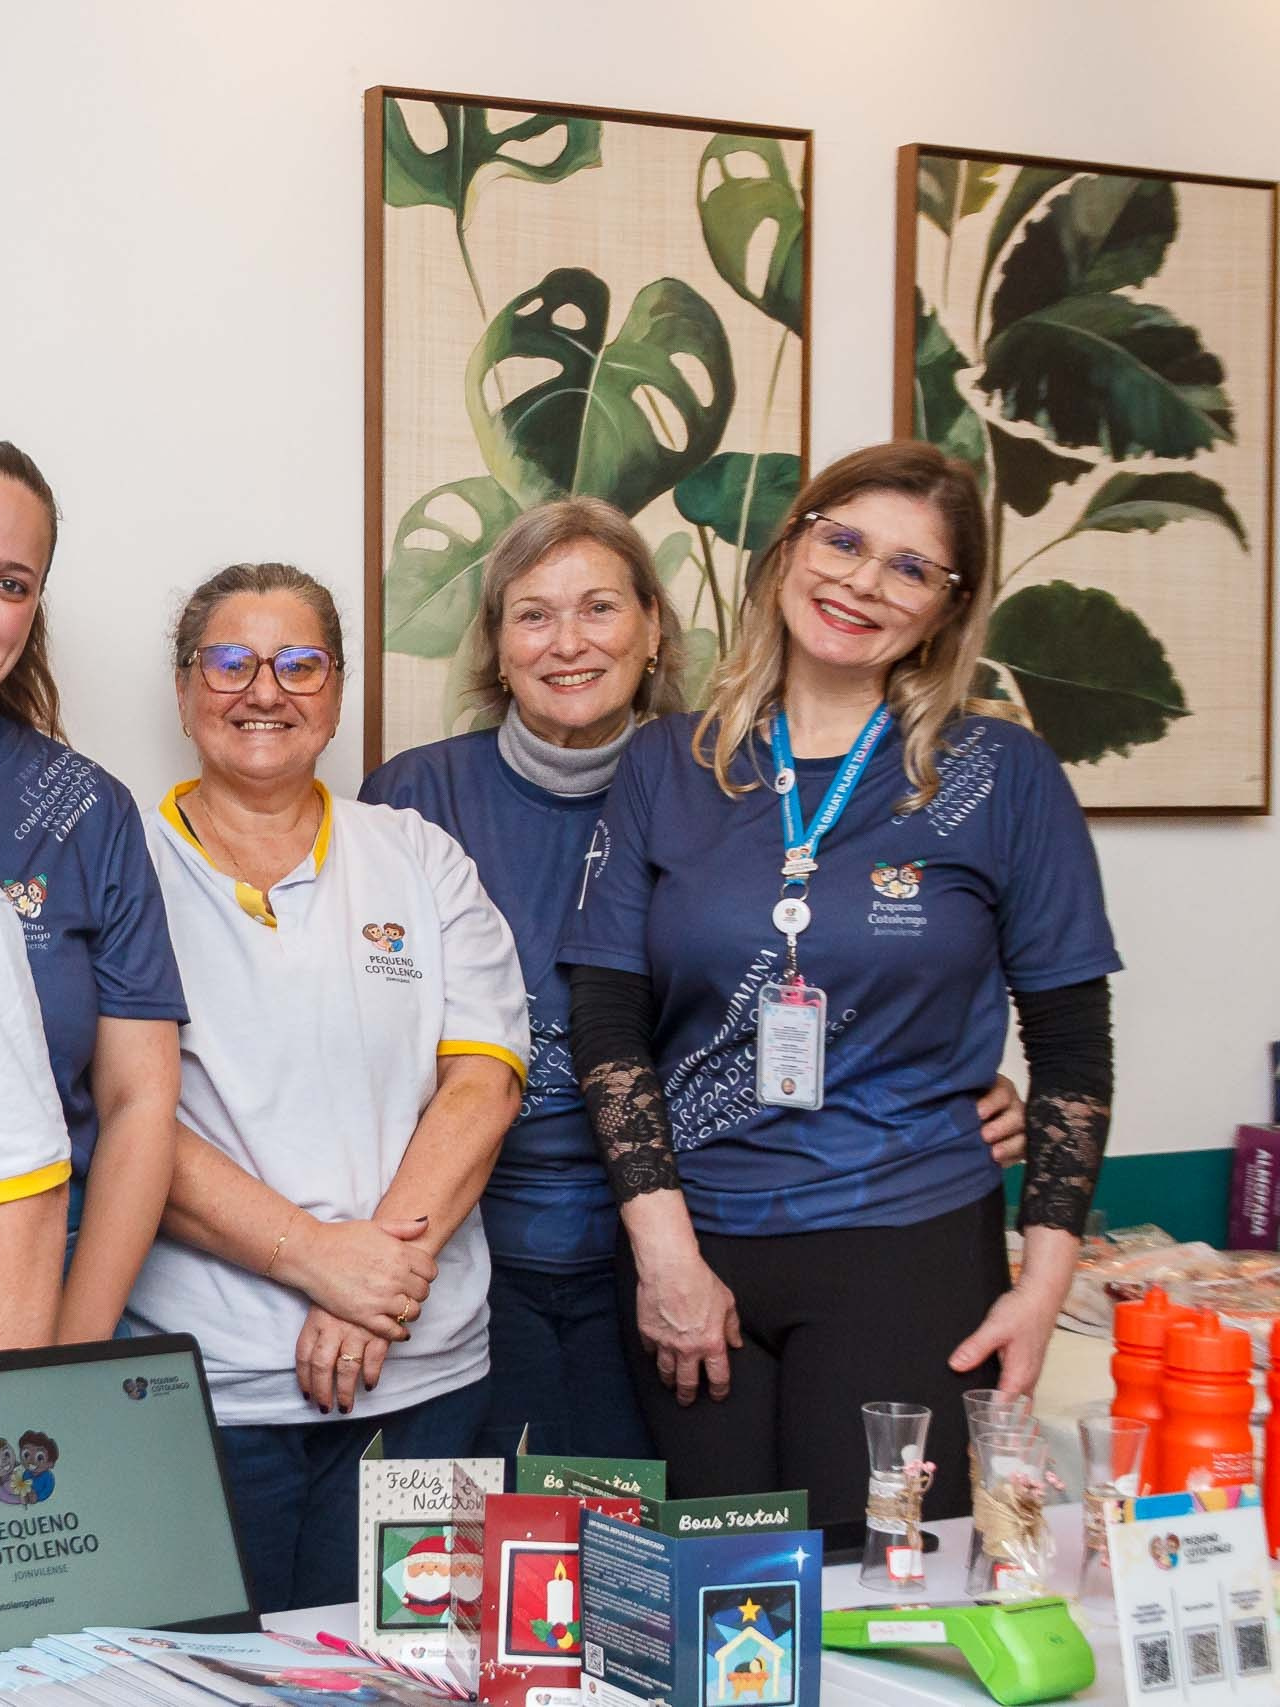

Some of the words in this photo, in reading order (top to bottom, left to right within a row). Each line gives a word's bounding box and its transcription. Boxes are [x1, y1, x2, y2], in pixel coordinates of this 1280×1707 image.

[20, 785, 42, 807] FÉ
[39, 748, 73, 788] CARIDA
[14, 760, 82, 840] COMPROMISSO
[822, 794, 845, 824] GREAT
[837, 763, 860, 793] PLACE
[365, 965, 423, 979] COTOLENGO
[369, 955, 414, 967] PEQUENO
[387, 1469, 444, 1495] Feliz
[678, 1515, 723, 1531] Boas
[725, 1507, 789, 1527] Festas!
[13, 1564, 70, 1582] JOINVILENSE
